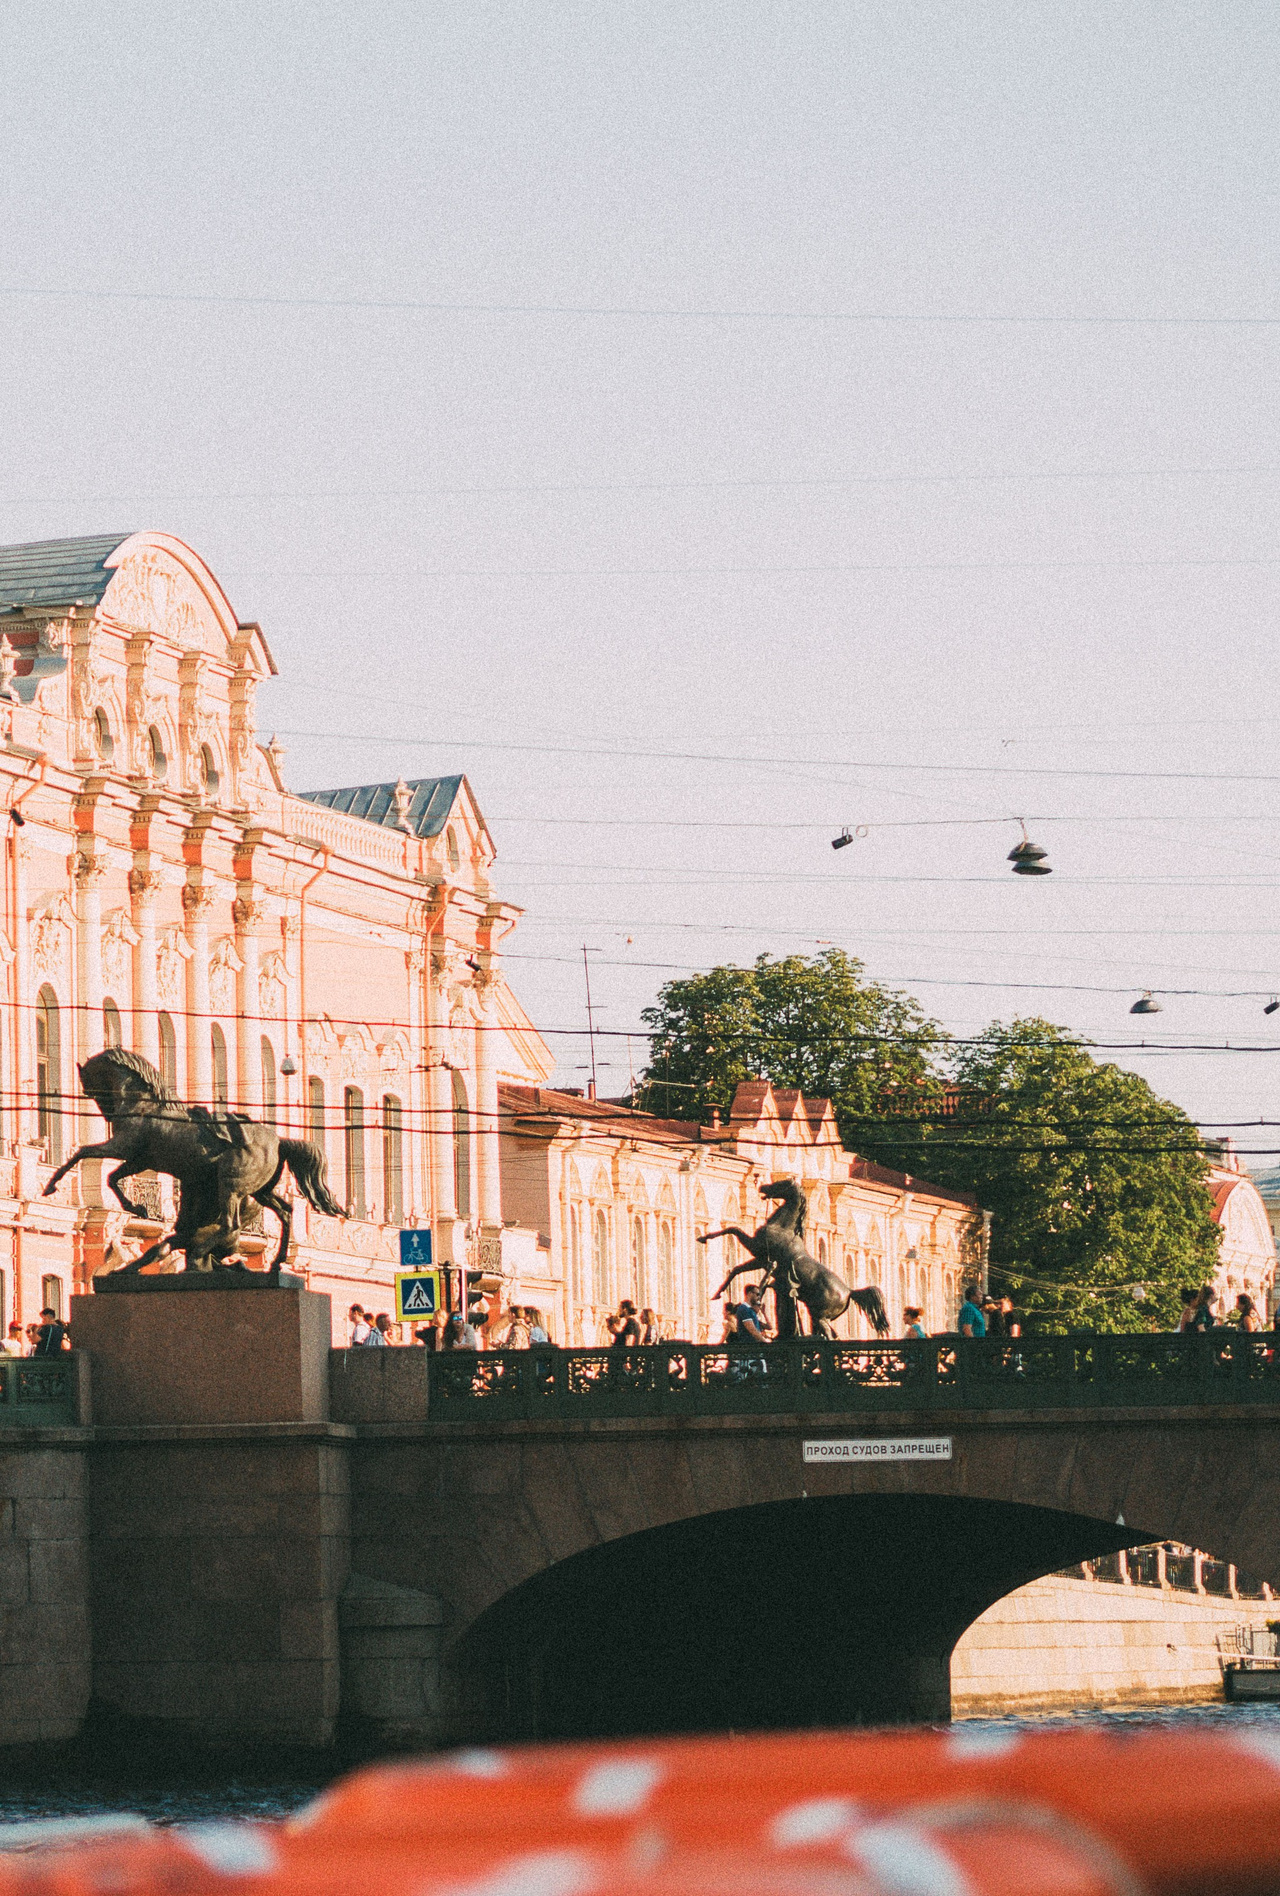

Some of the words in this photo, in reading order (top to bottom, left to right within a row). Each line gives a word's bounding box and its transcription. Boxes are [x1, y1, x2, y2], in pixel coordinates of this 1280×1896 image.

[806, 1446, 850, 1456] ПРОХОД
[852, 1445, 887, 1455] СУДОВ
[890, 1444, 949, 1454] ЗАПРЕЩЕН
